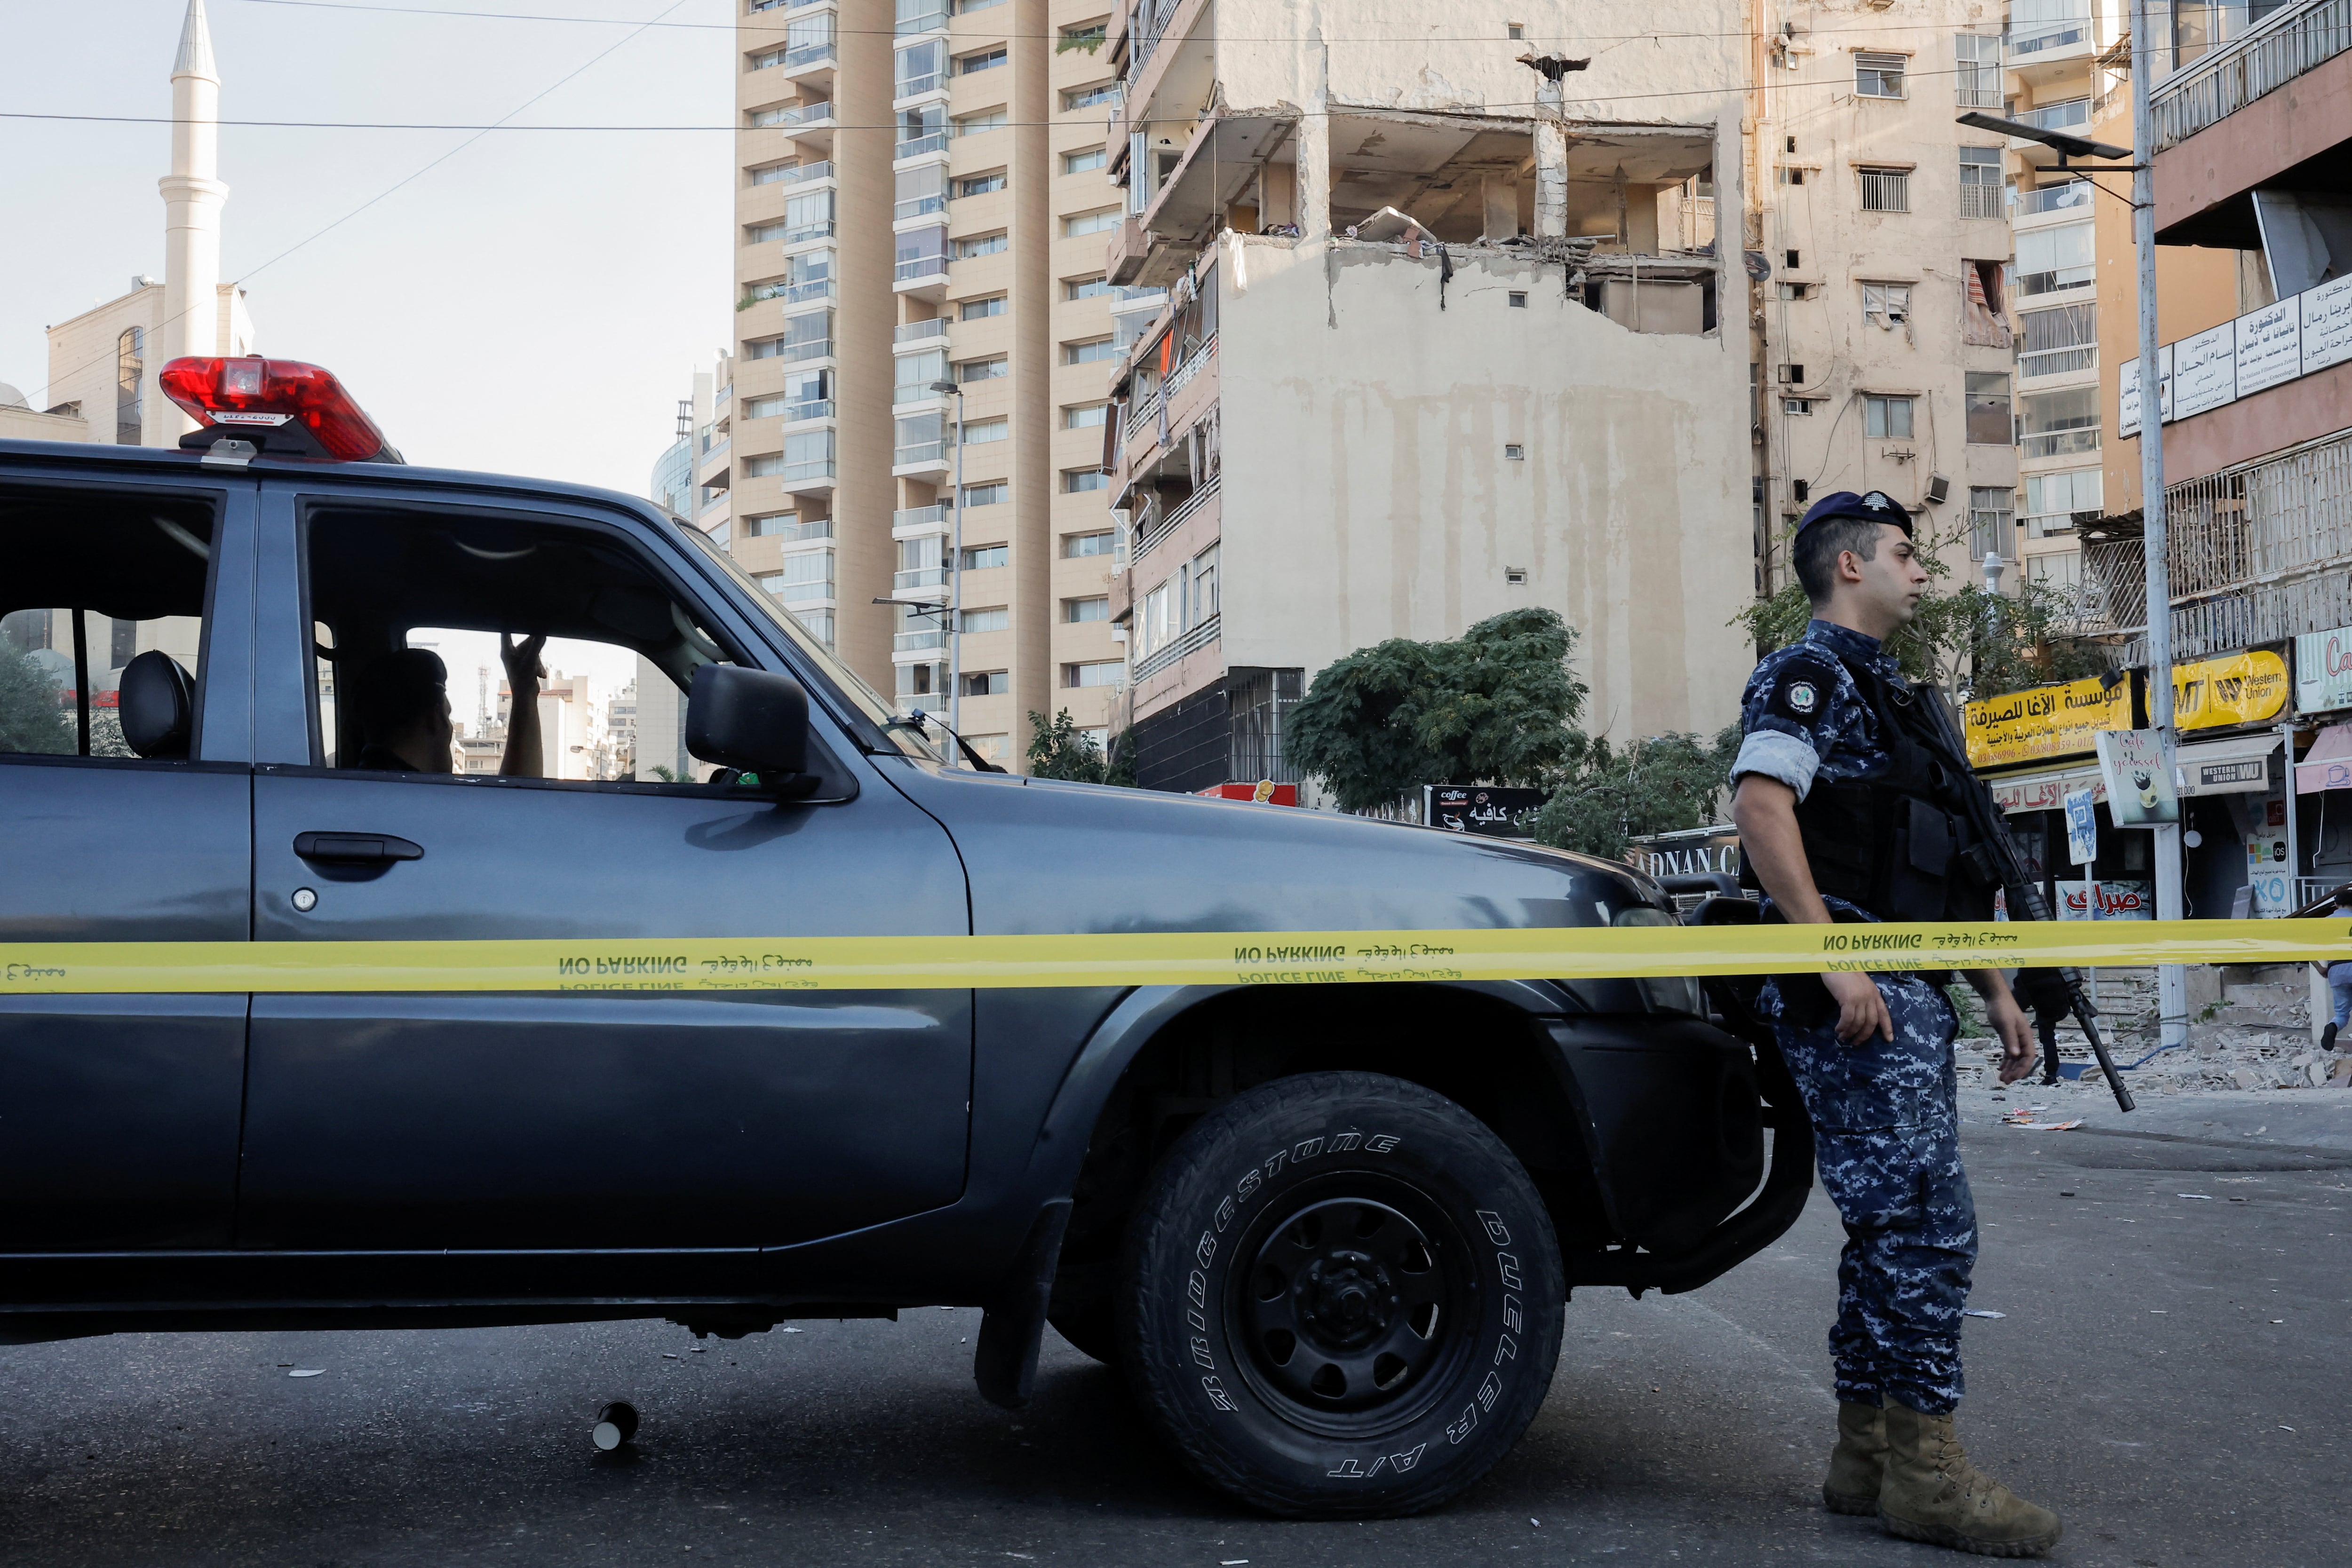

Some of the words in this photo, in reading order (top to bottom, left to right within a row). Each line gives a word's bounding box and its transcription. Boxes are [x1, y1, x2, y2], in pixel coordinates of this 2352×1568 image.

[2249, 306, 2286, 334] الدكتورة
[2191, 333, 2219, 353] الدكتور
[2209, 348, 2233, 365] بسام
[2327, 636, 2352, 677] Ca
[2173, 680, 2204, 714] MT
[2245, 672, 2281, 687] Western
[2246, 687, 2272, 700] Union
[1978, 748, 2016, 763] 03/686996
[2030, 739, 2070, 754] 03/808359
[2202, 766, 2236, 776] WESTERN
[2239, 763, 2259, 779] WU
[2213, 773, 2236, 782] UNION
[1441, 790, 1467, 800] coffee
[2185, 785, 2195, 795] 000
[1469, 803, 1508, 826] كافيه
[1637, 847, 1712, 877] ADNAN
[2274, 847, 2285, 856] iOS
[1186, 1132, 1400, 1412] BRIDGESTONE
[1446, 1209, 1524, 1445] DUELER
[1327, 1441, 1427, 1478] A/T
